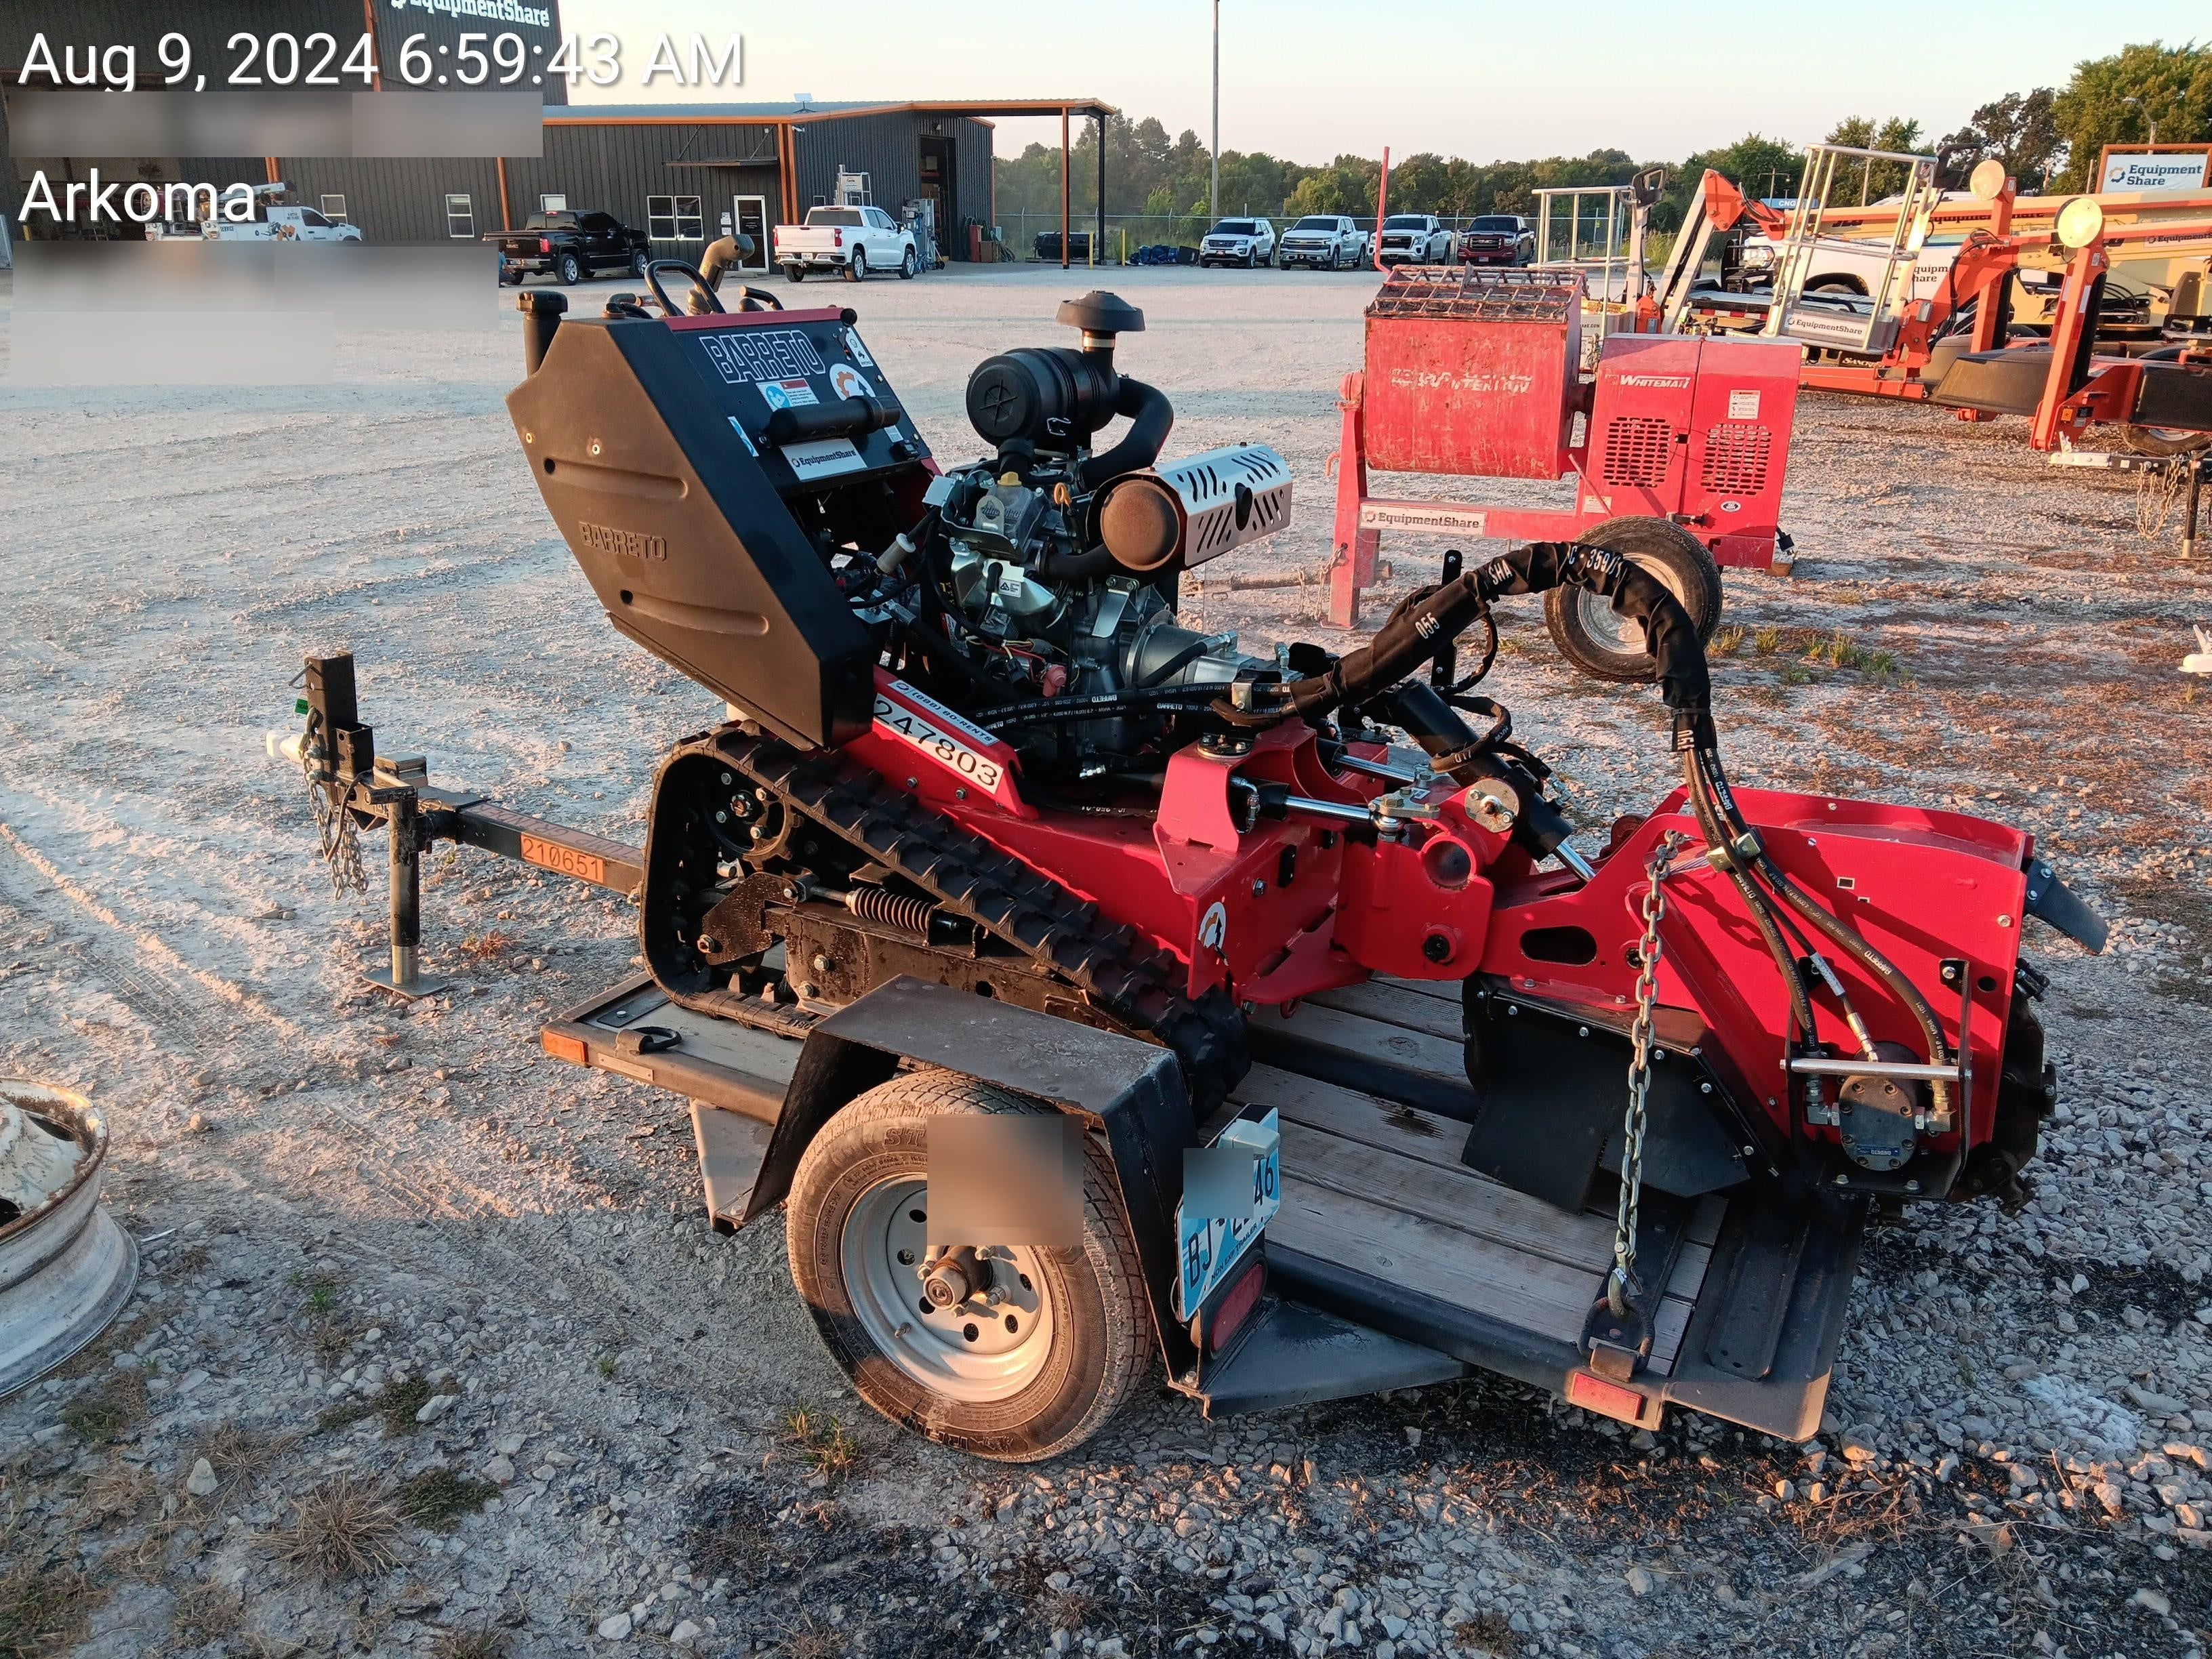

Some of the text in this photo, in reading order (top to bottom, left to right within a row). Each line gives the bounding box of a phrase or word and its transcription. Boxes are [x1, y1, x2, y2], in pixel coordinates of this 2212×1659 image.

[2127, 176, 2166, 186] Share
[2129, 164, 2203, 176] Equipment
[1914, 265, 1948, 274] quipm
[1796, 319, 1863, 335] EquipmentShare
[699, 330, 825, 384] BARRETO
[800, 449, 857, 466] EquipmentShare
[1378, 512, 1480, 529] EquipmentShare
[579, 521, 667, 562] BARRETO
[1488, 559, 1513, 586] SHA
[1415, 612, 1440, 639] 055
[1092, 694, 1118, 703] BARRETO
[943, 710, 993, 742] 80-RENTS
[874, 700, 998, 786] 247803
[1715, 781, 1734, 811] BARRETO
[472, 804, 570, 837] GRINDER
[522, 838, 599, 880] 210651
[1862, 949, 1893, 976] BARRETO
[1916, 1000, 1927, 1015] 1021
[1927, 1019, 1938, 1035] MSHA
[1210, 1224, 1258, 1280] NON EXP TRAILER
